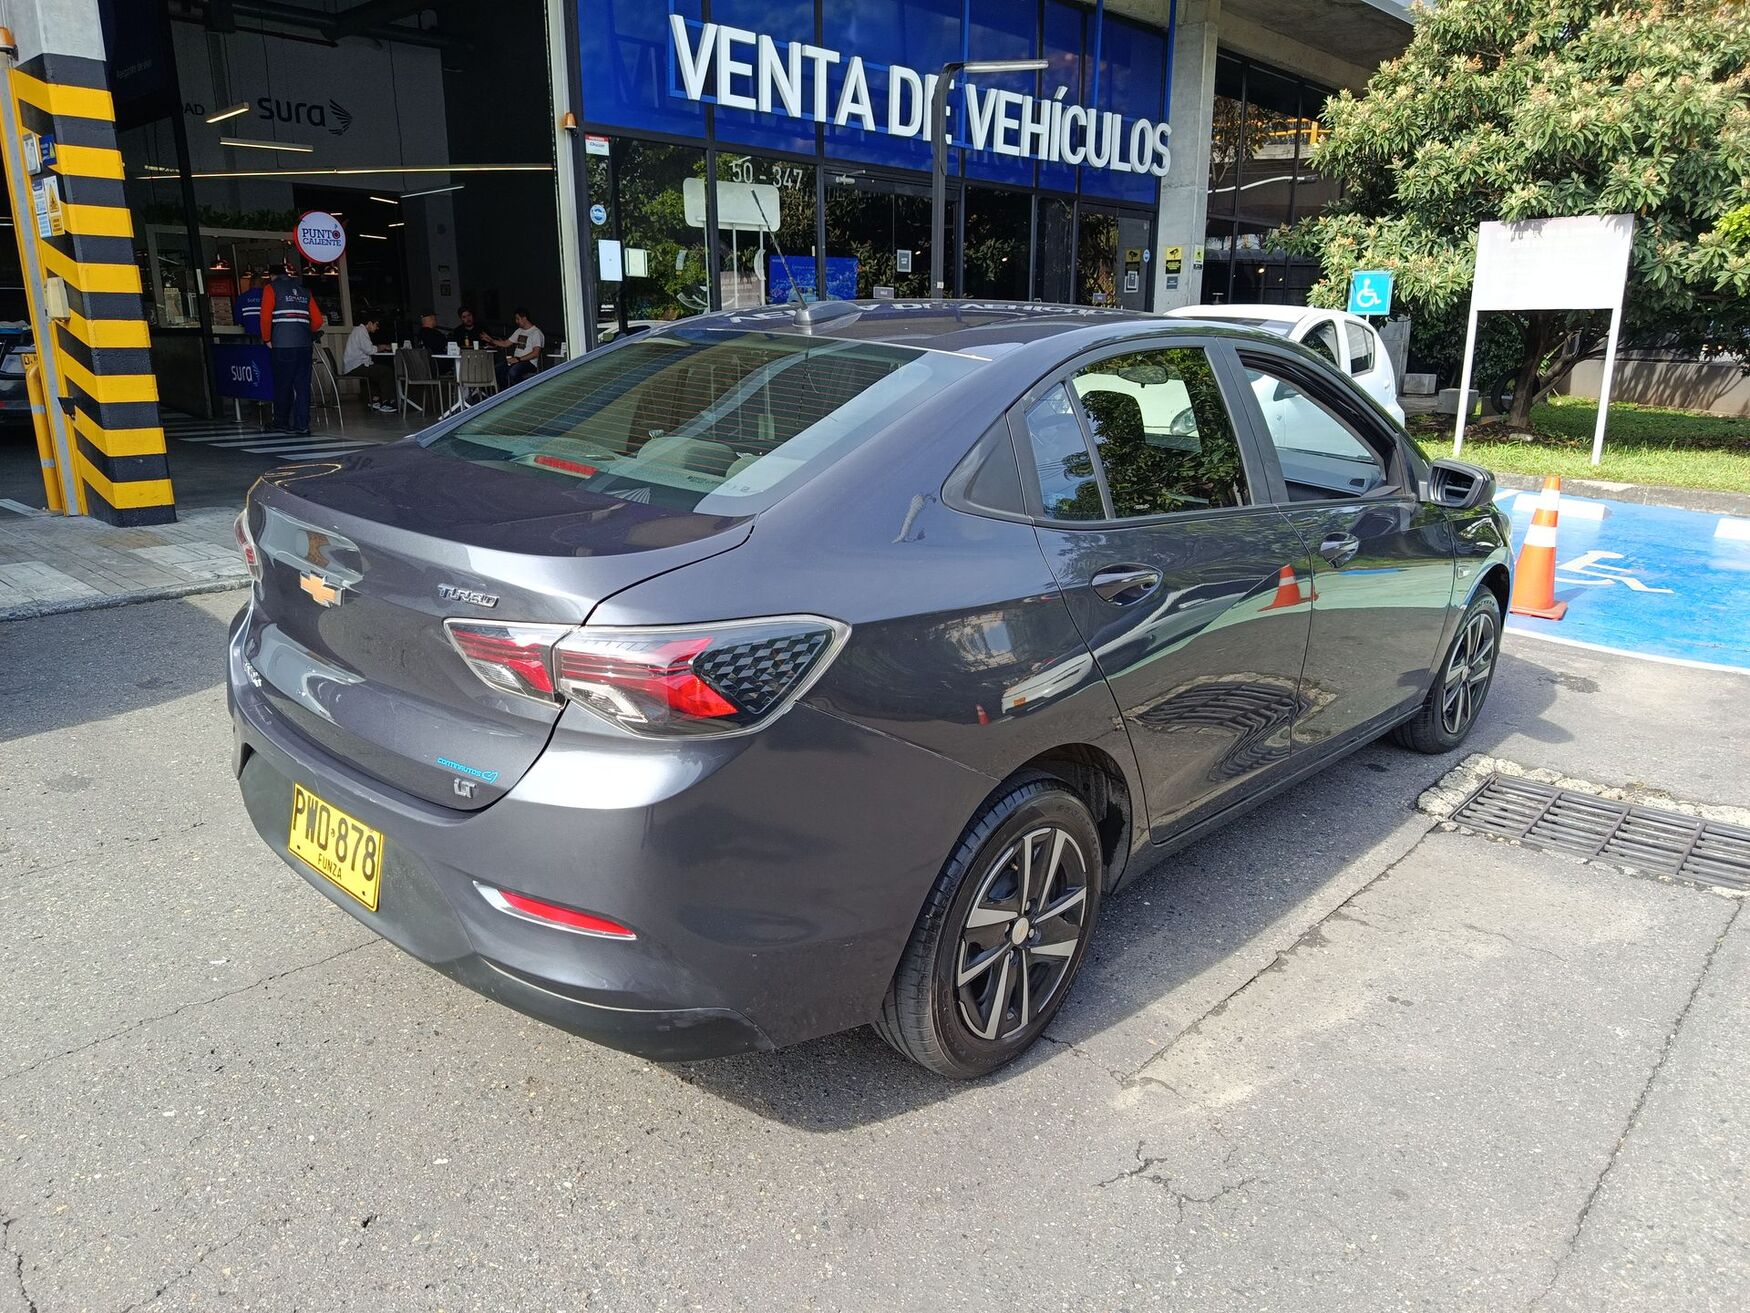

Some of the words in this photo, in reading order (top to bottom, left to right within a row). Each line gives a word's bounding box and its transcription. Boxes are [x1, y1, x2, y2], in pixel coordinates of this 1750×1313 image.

[669, 14, 876, 131] VENTA
[888, 65, 955, 145] DE
[965, 86, 1172, 177] VEHÍCULOS
[257, 97, 326, 128] sura
[732, 160, 754, 184] 50
[772, 166, 803, 190] 347
[302, 228, 341, 240] PUNTO
[302, 237, 342, 247] CALIENTE
[231, 365, 254, 382] sura
[437, 583, 500, 608] TURBO
[454, 777, 477, 799] LT
[317, 853, 343, 881] FUNZA
